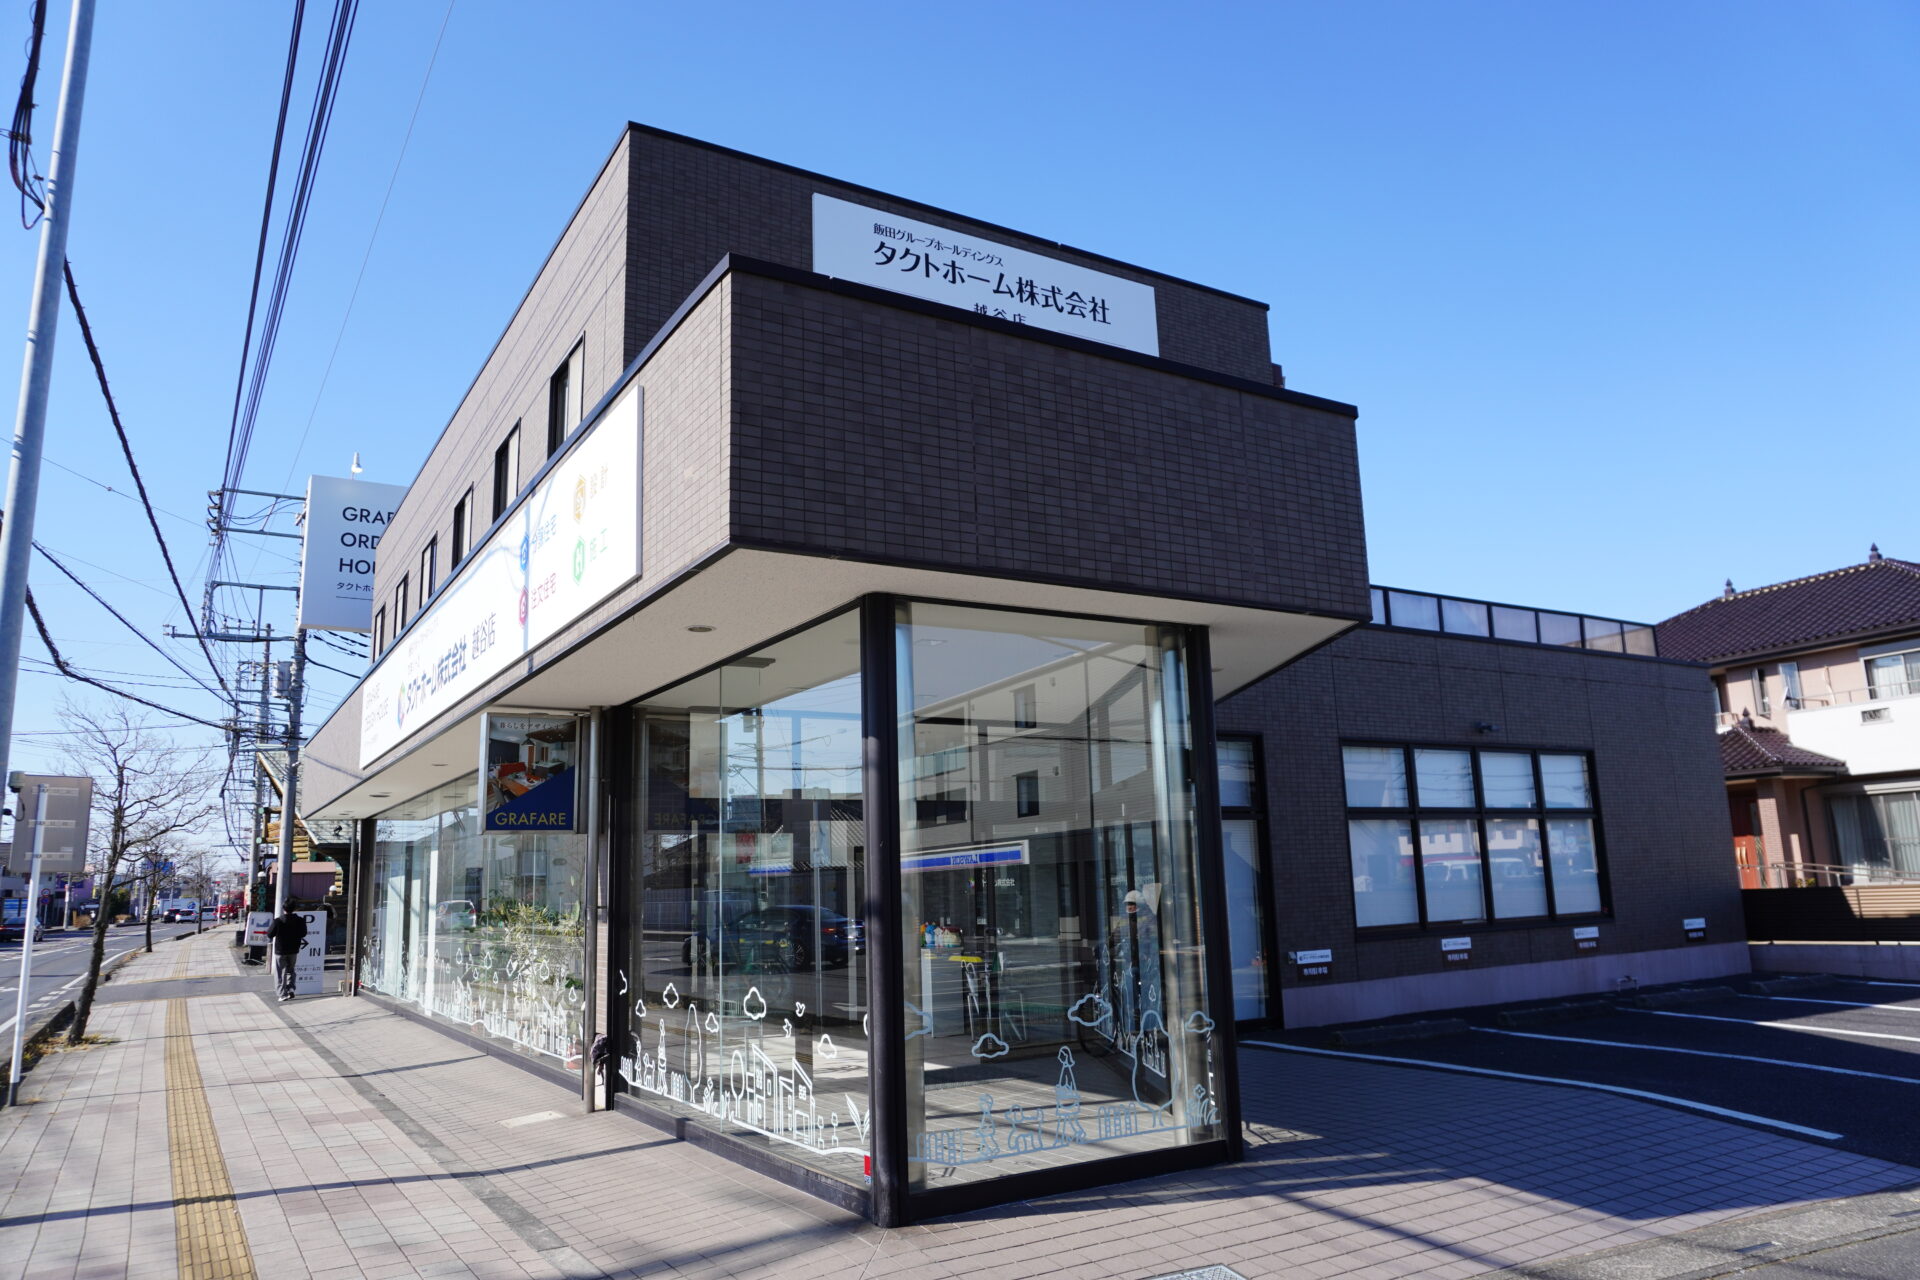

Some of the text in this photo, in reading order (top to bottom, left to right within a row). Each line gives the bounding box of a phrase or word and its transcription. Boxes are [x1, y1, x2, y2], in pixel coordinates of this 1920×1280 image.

[873, 222, 1004, 267] 飯田グループホールディングス
[873, 240, 1111, 325] タクトホーム株式会社
[338, 558, 375, 575] HO
[336, 582, 374, 592] タクトホ
[471, 611, 497, 661] 越谷店
[405, 633, 468, 715] タクトホーム株式会社
[494, 811, 567, 826] GRAFARE
[309, 948, 321, 957] IN
